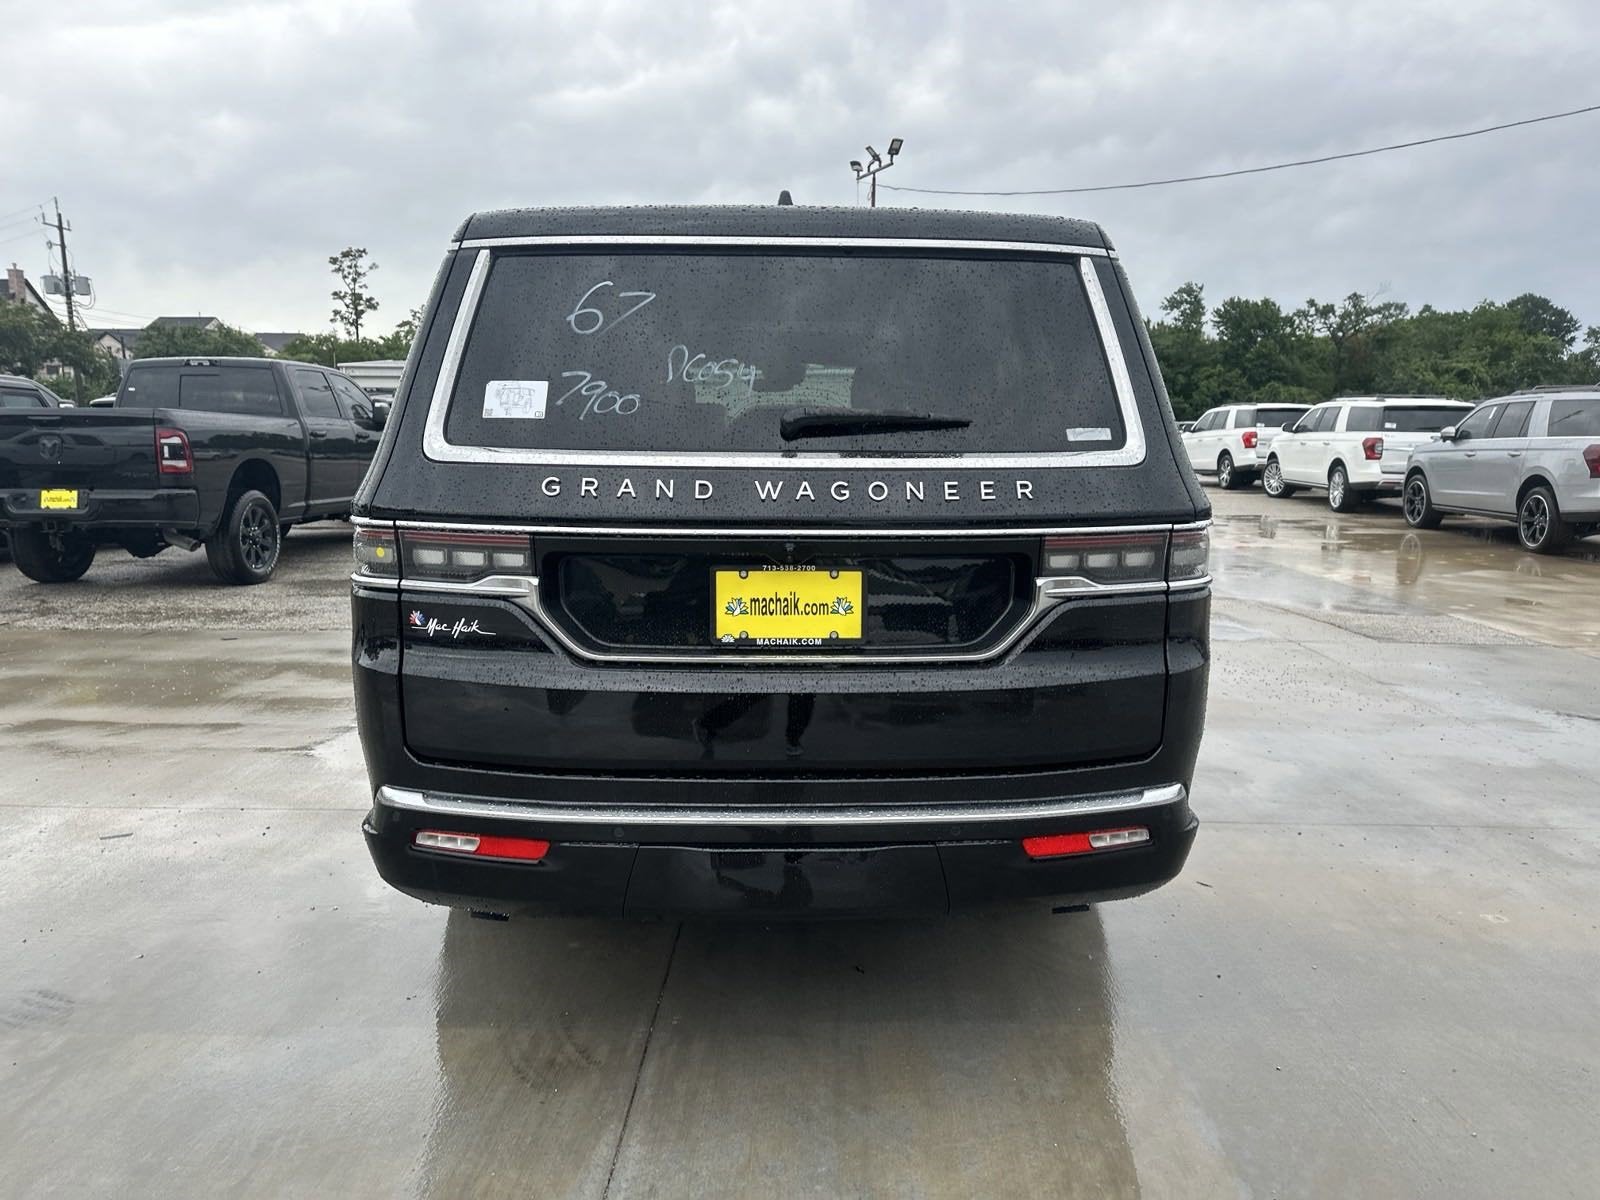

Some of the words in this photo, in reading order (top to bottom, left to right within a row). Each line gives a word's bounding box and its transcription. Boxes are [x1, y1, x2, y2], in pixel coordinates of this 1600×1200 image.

[566, 281, 656, 336] 67
[555, 371, 640, 420] 7900
[541, 476, 714, 500] GRAND
[754, 480, 1034, 501] WAGONEER
[750, 591, 829, 616] machaik.com
[412, 617, 452, 637] Mac
[451, 617, 496, 639] Haik
